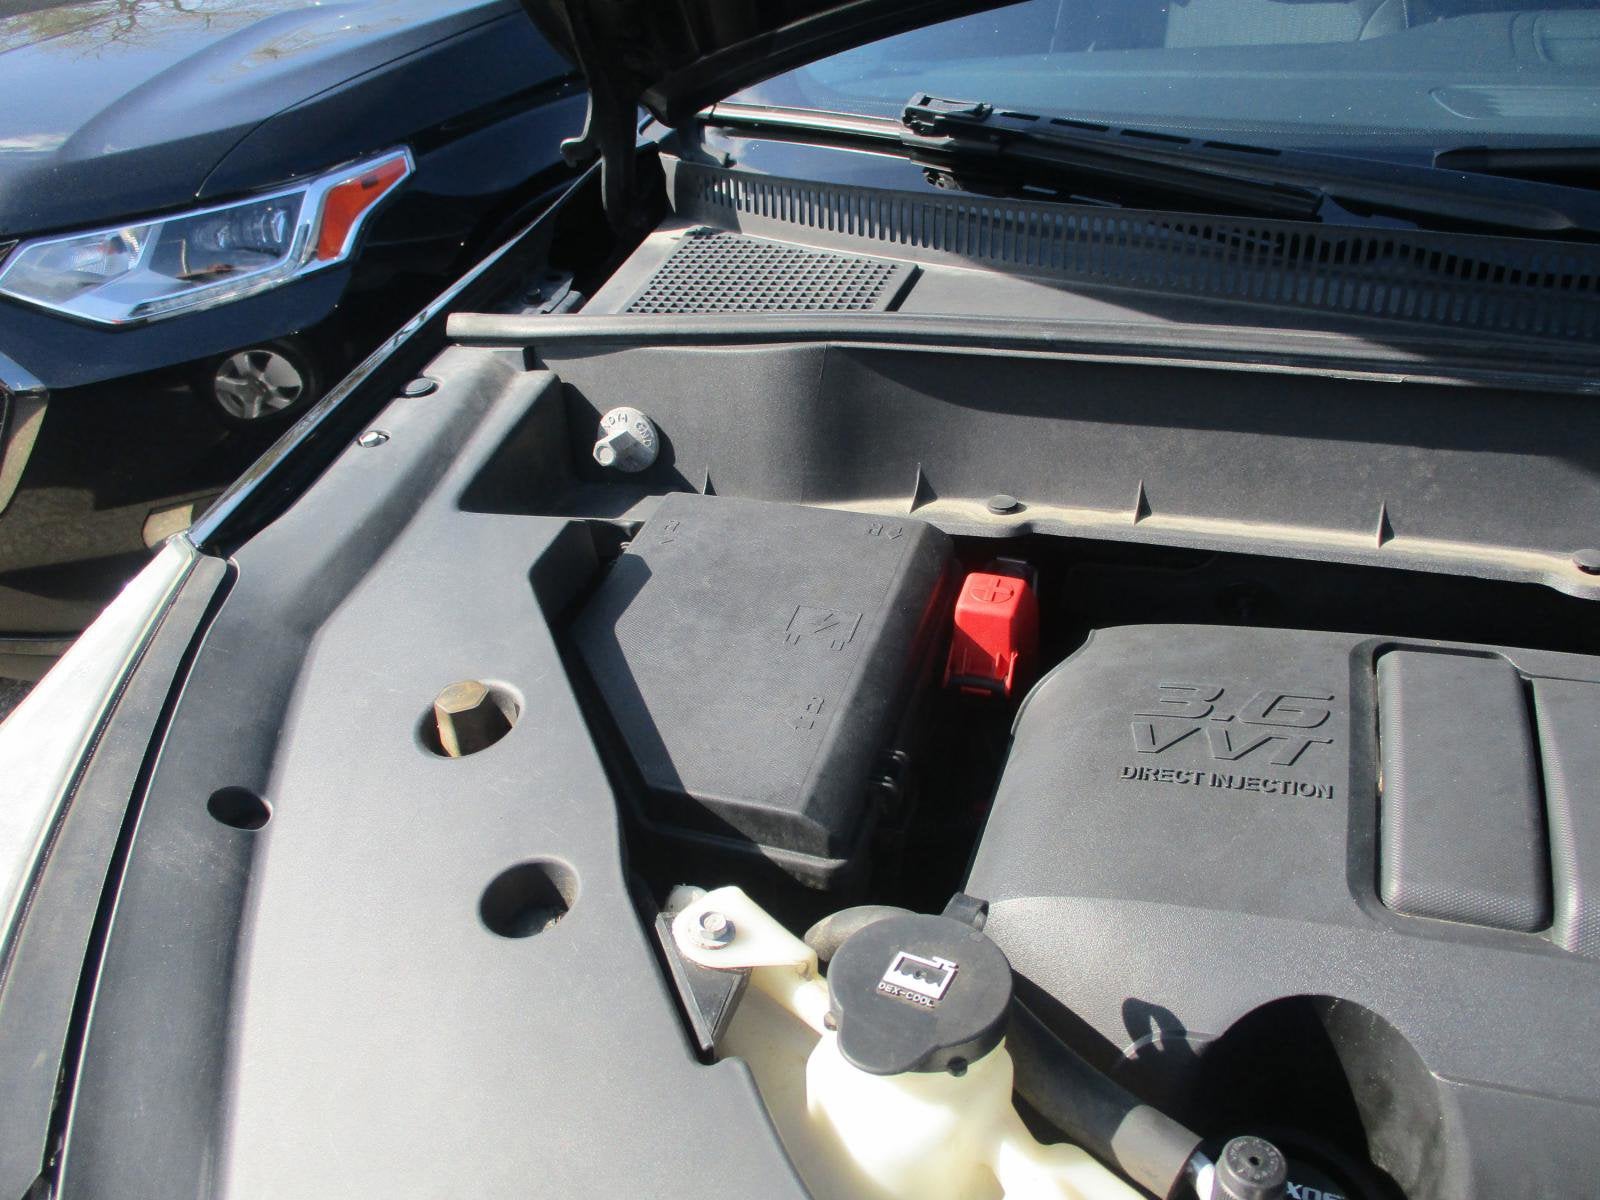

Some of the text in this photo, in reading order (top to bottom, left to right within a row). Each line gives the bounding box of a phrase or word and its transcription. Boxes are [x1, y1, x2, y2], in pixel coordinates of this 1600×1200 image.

[1133, 680, 1336, 729] 3.6
[1130, 720, 1335, 767] VVT
[1120, 765, 1335, 800] DIRECT INJECTION
